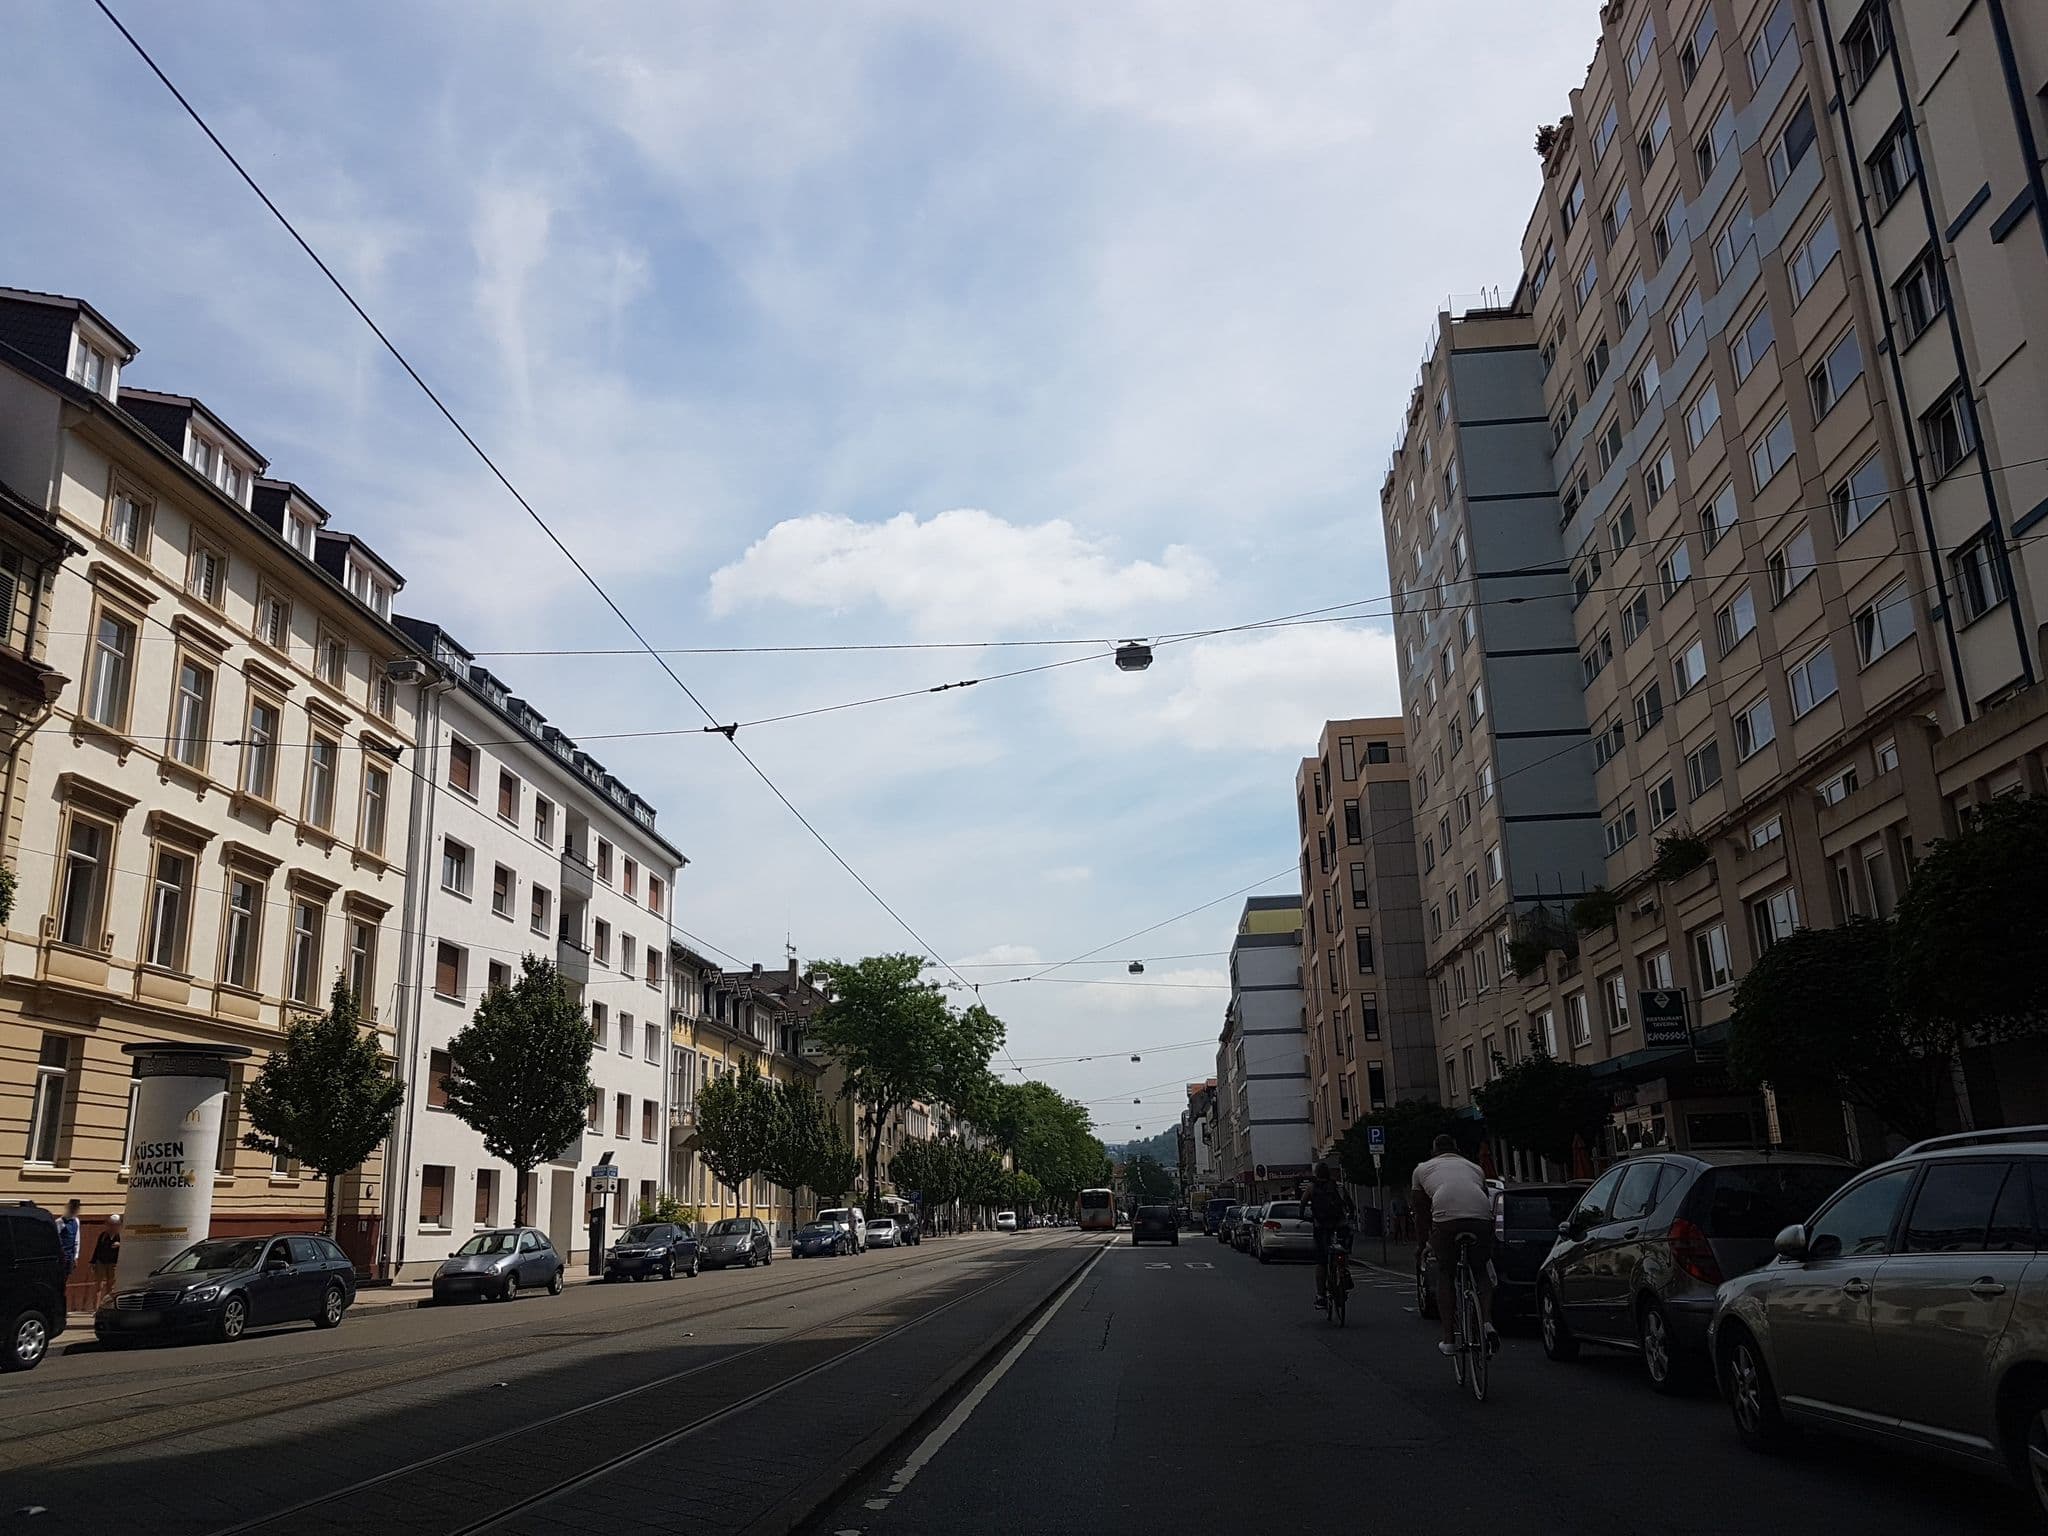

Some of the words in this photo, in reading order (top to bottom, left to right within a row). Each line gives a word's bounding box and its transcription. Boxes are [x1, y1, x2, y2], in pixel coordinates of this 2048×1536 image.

[1647, 1031, 1687, 1042] KNOSSOS
[1371, 1128, 1381, 1143] P
[134, 1141, 184, 1161] KÜSSEN
[135, 1161, 184, 1175] MACHT
